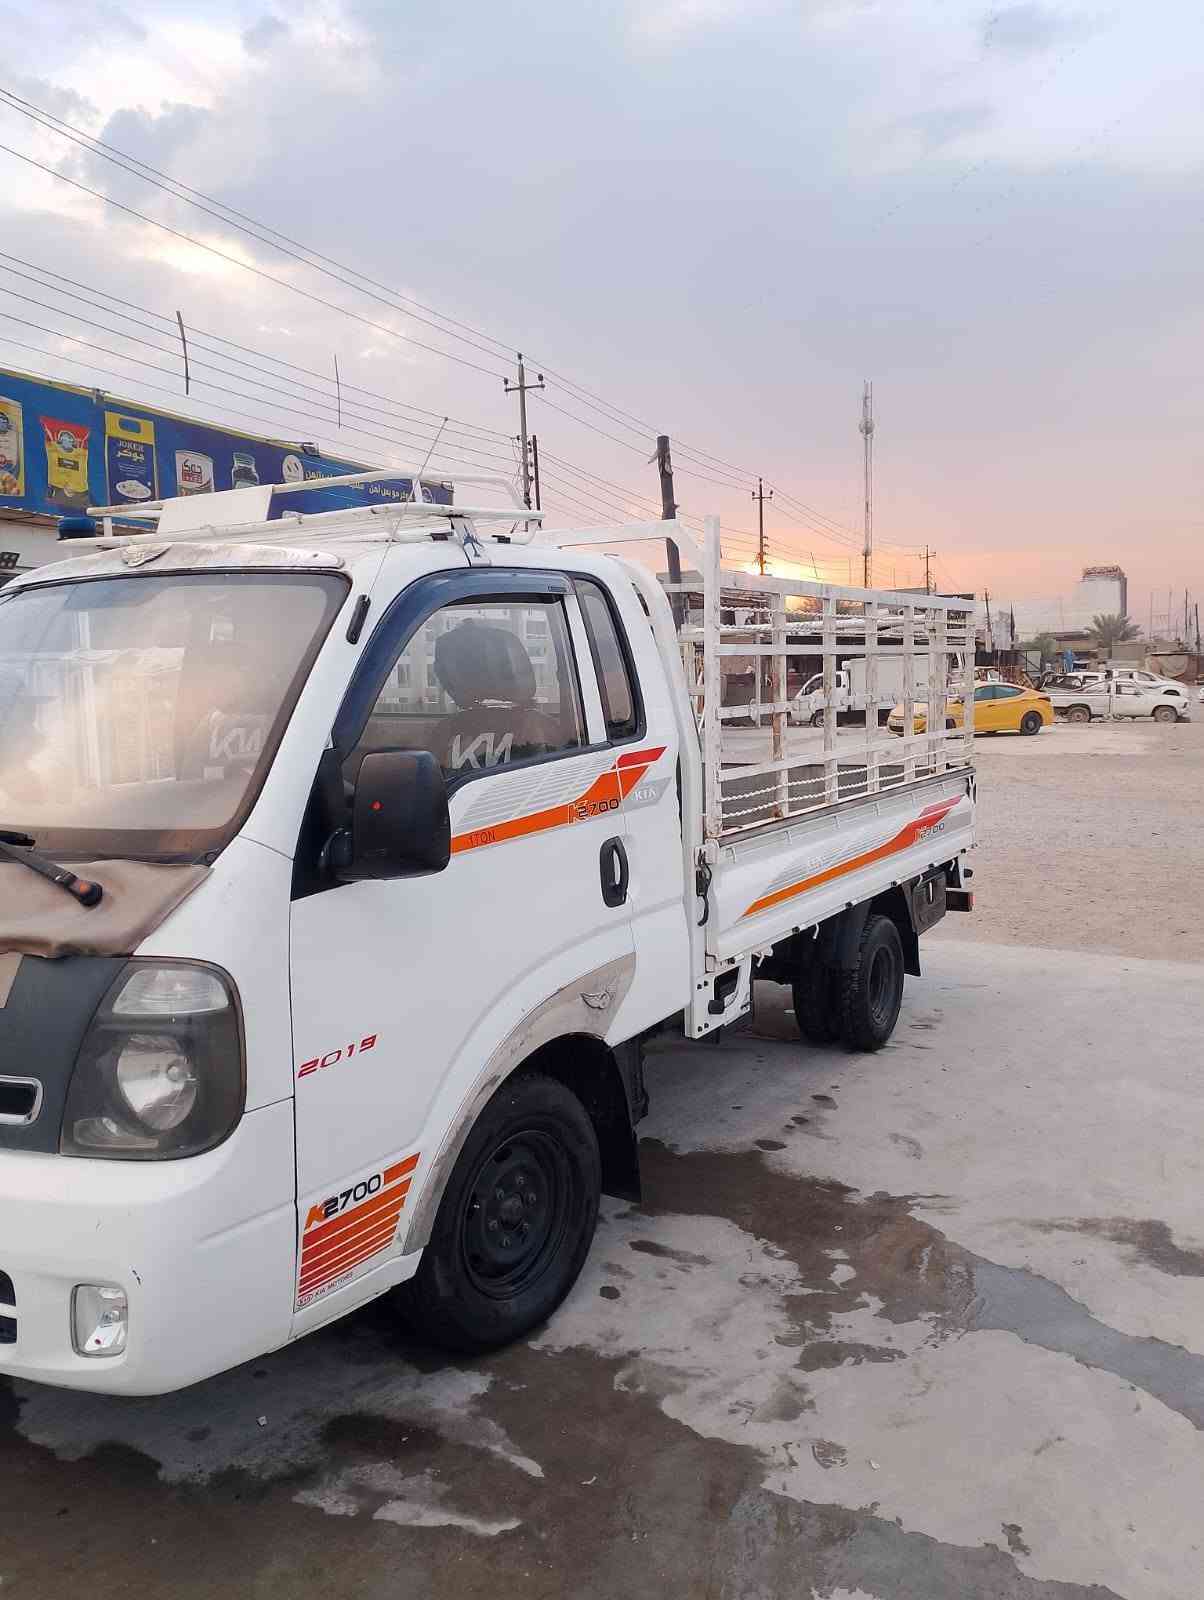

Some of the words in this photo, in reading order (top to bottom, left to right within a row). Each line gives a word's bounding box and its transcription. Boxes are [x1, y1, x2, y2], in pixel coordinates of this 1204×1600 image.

[634, 788, 657, 800] KIA
[568, 798, 619, 824] K2700
[298, 1034, 377, 1078] 2019
[304, 1173, 381, 1231] K2700
[315, 1287, 326, 1298] KIA
[327, 1271, 353, 1289] MOTORS
